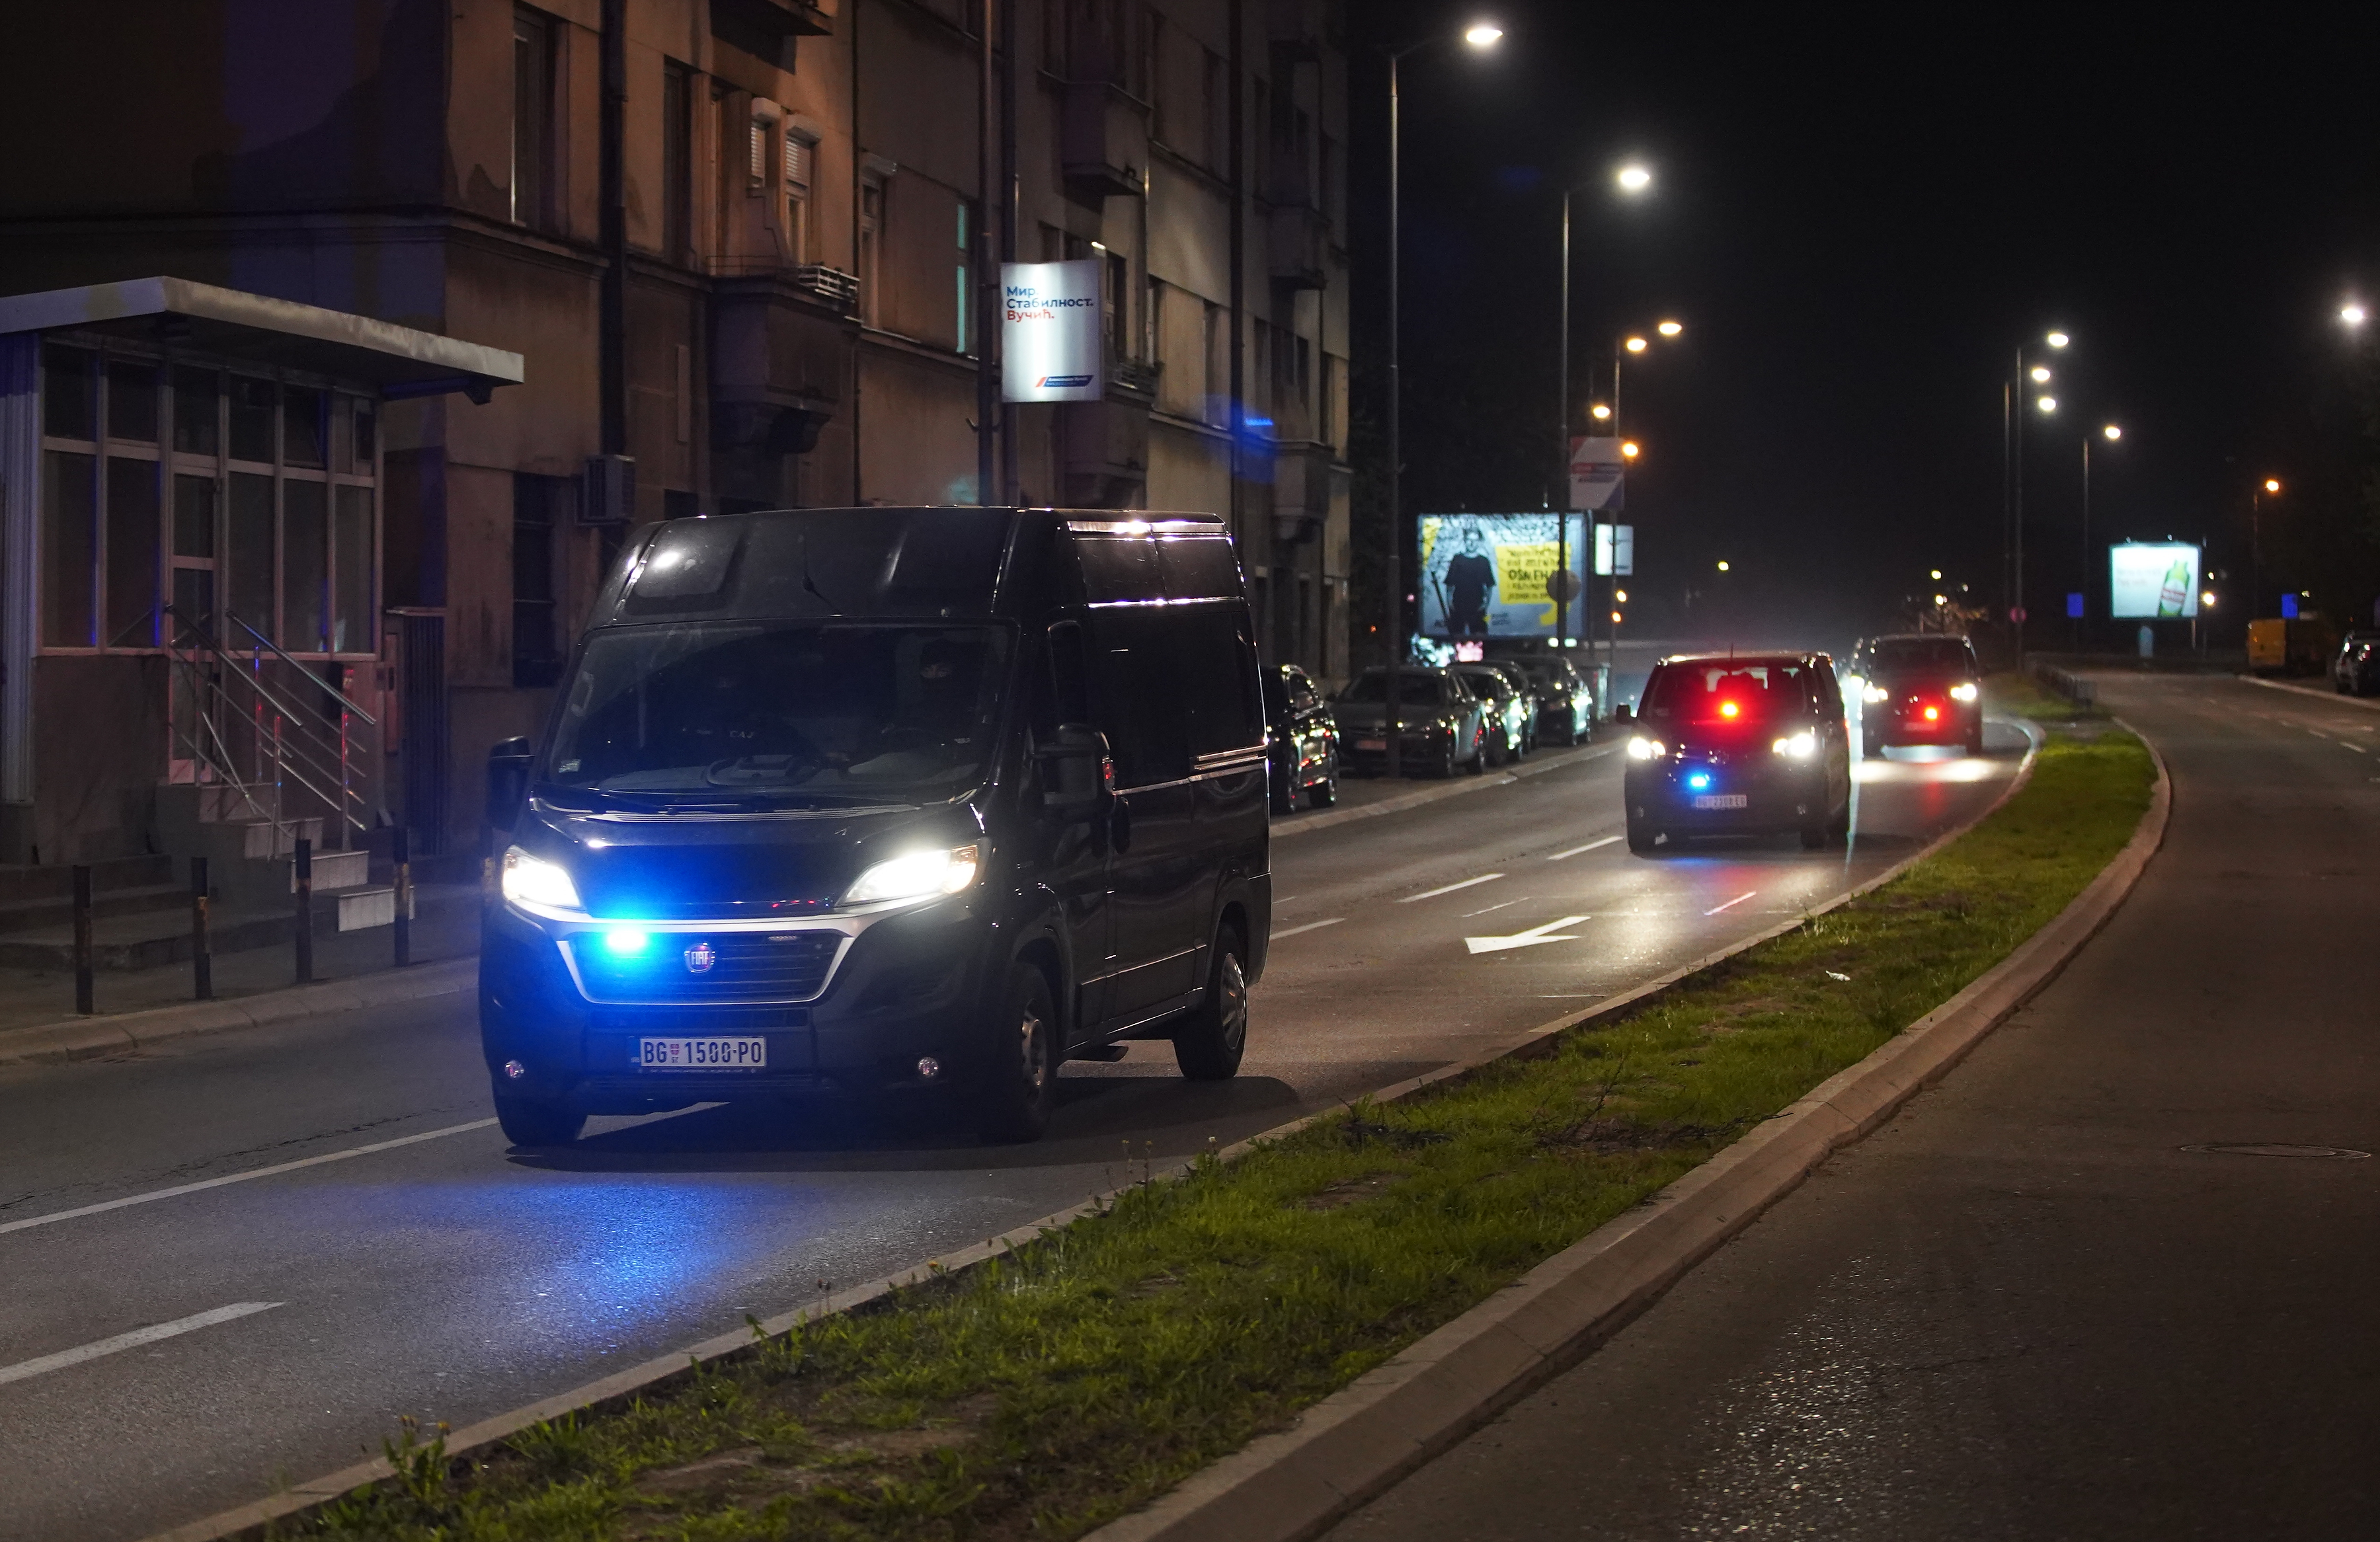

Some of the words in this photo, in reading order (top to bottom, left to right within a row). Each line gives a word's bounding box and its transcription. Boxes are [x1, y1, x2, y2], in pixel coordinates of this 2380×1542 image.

[1007, 286, 1039, 298] Мир.
[1007, 297, 1093, 309] Стабилност.
[1007, 309, 1054, 323] Вучић.
[691, 950, 709, 965] FIAT
[643, 1041, 667, 1064] BG
